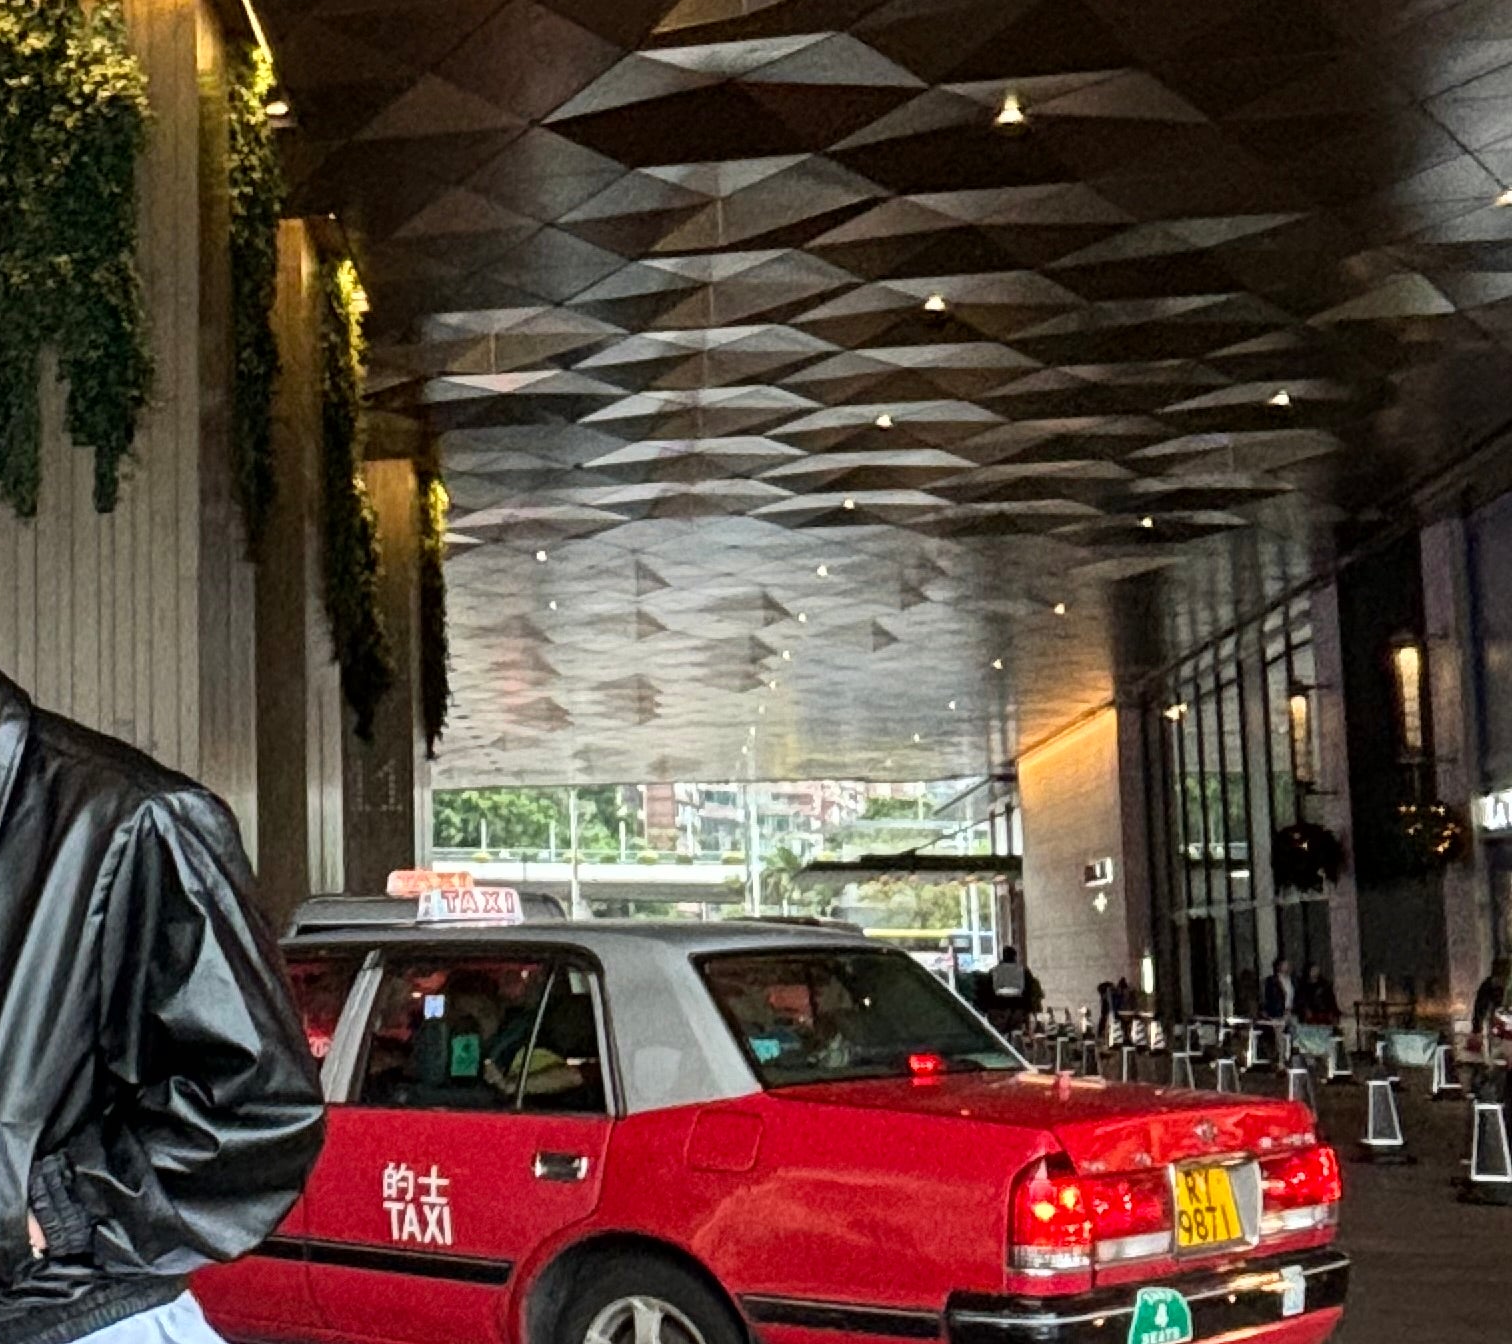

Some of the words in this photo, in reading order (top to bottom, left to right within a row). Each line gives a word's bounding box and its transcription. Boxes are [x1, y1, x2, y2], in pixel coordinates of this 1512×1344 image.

[440, 889, 517, 914] TAXI
[382, 1161, 451, 1204] 的士
[382, 1201, 453, 1246] TAXI
[1178, 1203, 1232, 1244] 9871
[1154, 1302, 1169, 1328] 4
